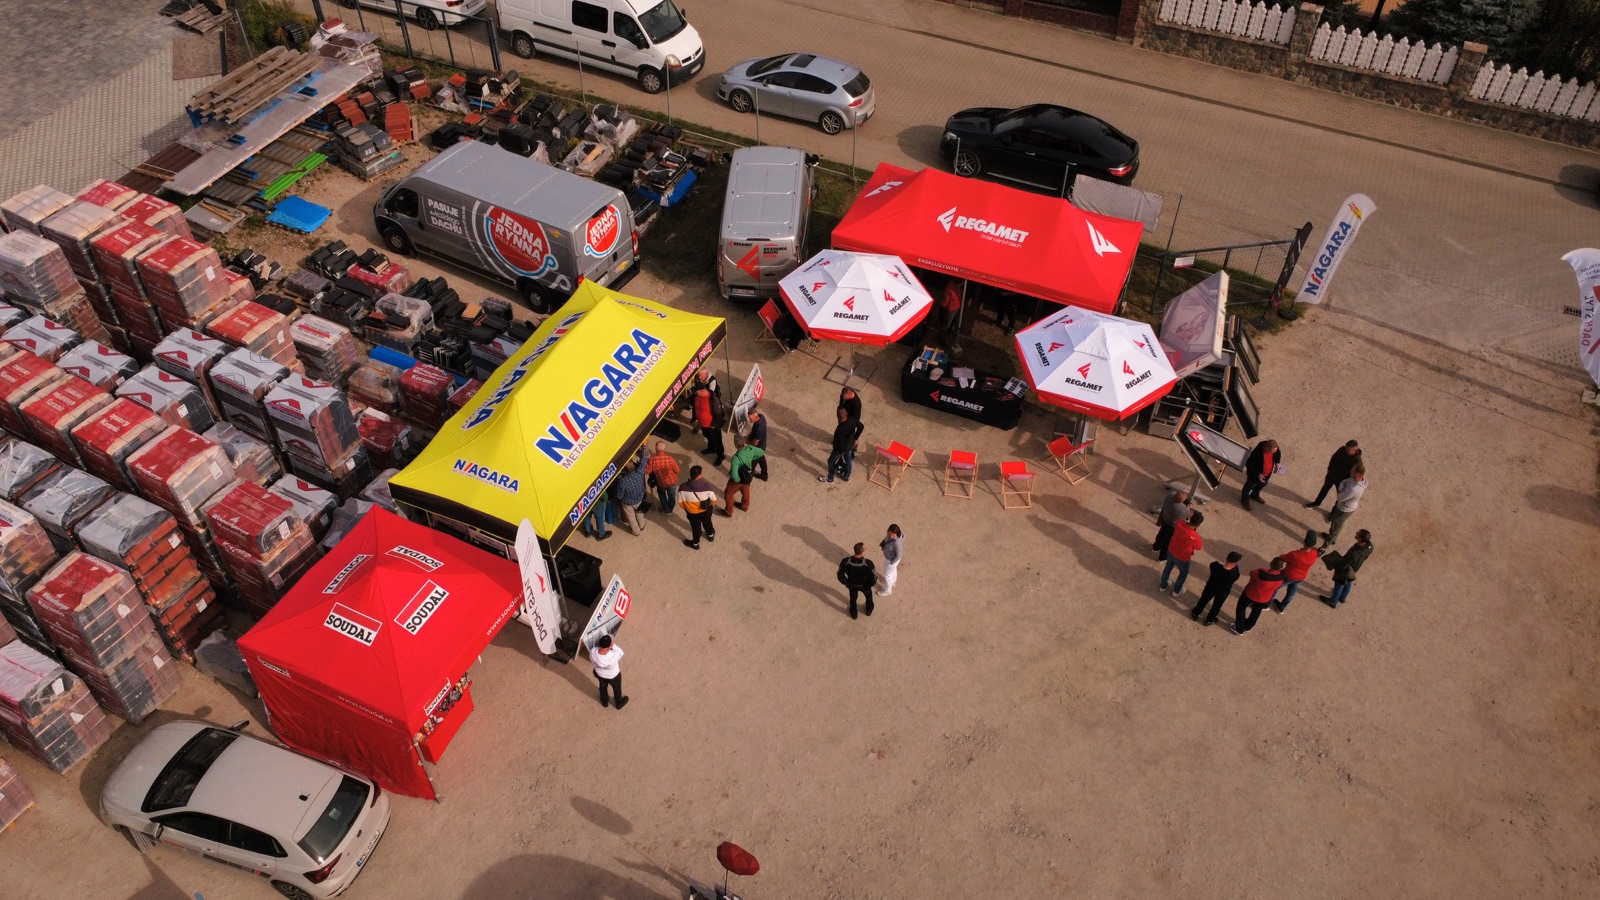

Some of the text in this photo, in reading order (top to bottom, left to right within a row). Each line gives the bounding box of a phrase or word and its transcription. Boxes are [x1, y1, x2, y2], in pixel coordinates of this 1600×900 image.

[428, 199, 459, 217] PASUJE
[431, 216, 463, 234] DACHU
[497, 211, 543, 252] JEDNA
[590, 209, 612, 238] JEDNA
[590, 216, 615, 246] RYNNA
[954, 215, 1030, 243] REGAMET
[495, 222, 541, 262] RYNNA
[918, 257, 959, 273] EKSKLUZYWNE
[1304, 221, 1352, 296] NIAGARA
[799, 284, 817, 306] REGAMET
[889, 295, 911, 316] REGAMET
[833, 311, 870, 321] REGAMET
[1035, 342, 1051, 367] REGAMET
[1065, 377, 1104, 392] REGAMET
[1125, 370, 1152, 390] REGAMET
[535, 328, 661, 464] NIAGARA
[562, 342, 668, 469] METALOWY SYSTEM RYNNOWY
[940, 394, 985, 412] REGAMET
[453, 458, 519, 492] NIAGARA
[569, 463, 617, 525] NIAGARA
[397, 546, 442, 568] SOUDAL
[324, 555, 365, 593] SOUDAL
[405, 590, 447, 633] SOUDAL
[326, 614, 373, 644] SOUDAL
